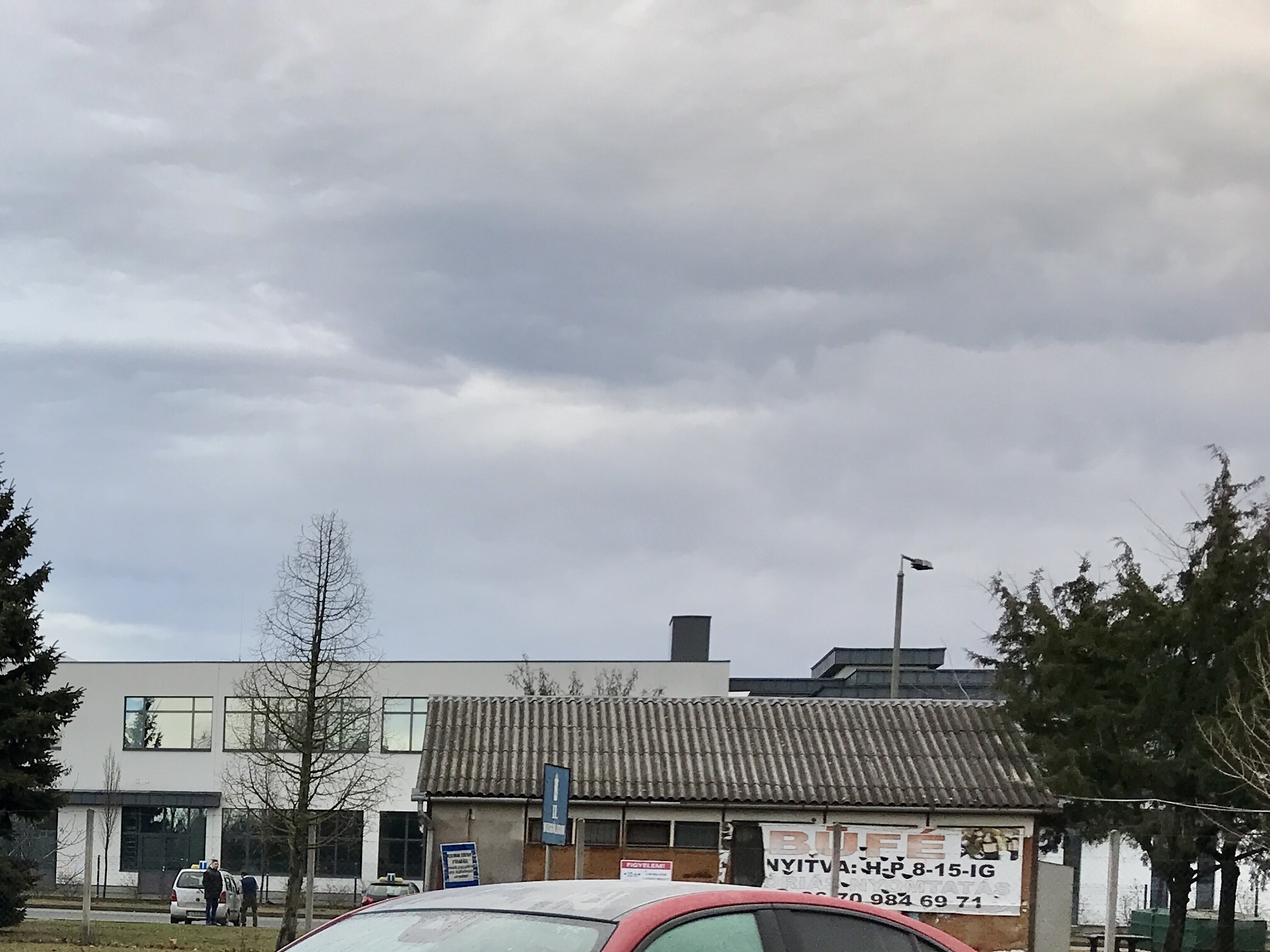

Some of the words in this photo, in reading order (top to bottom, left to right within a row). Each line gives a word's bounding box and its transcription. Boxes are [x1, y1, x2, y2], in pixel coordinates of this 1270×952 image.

[626, 862, 667, 870] FIGYELEM!
[766, 858, 857, 875] NYITVA:
[912, 862, 996, 878] 8-15-IG
[849, 877, 1011, 897] NYOMTATÁS
[870, 893, 913, 907] 984
[920, 894, 948, 908] 69
[956, 896, 982, 909] 71
